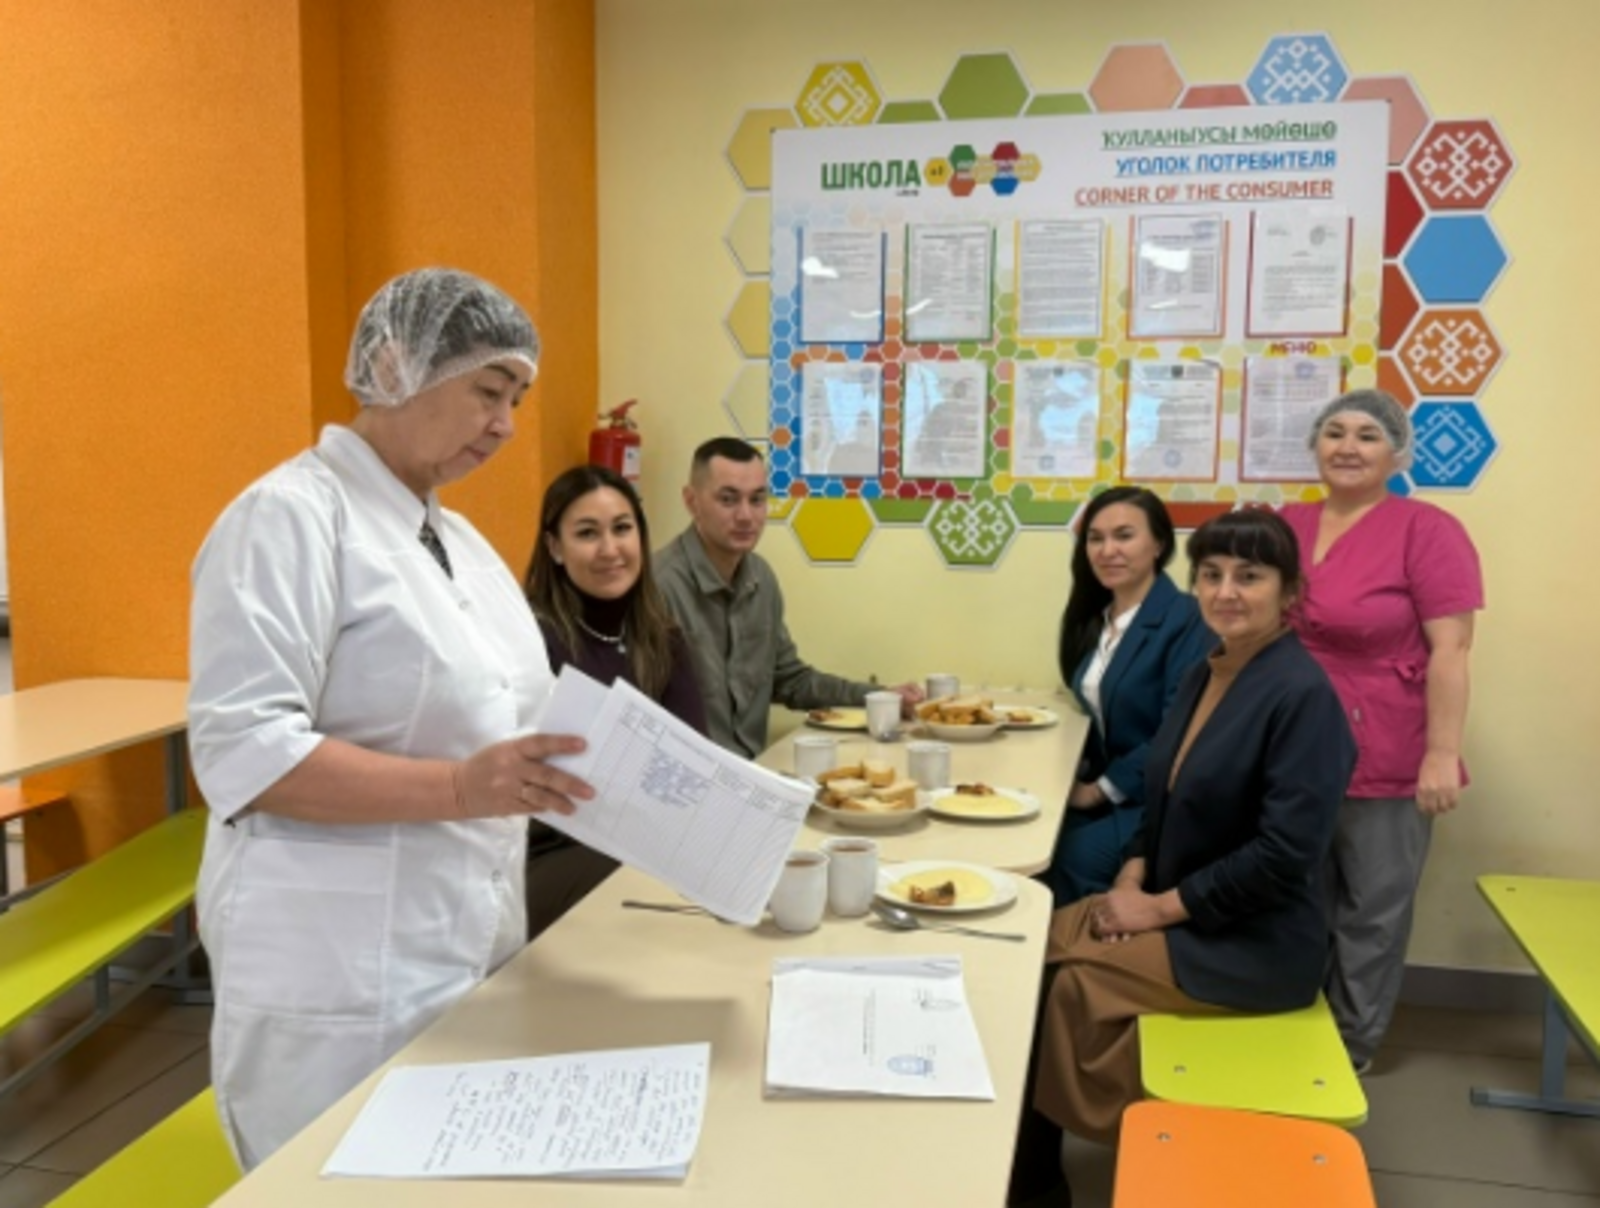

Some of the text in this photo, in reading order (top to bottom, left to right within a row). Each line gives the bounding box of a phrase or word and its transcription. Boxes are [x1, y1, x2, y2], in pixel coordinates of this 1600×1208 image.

[821, 159, 921, 190] ШКОЛА
[1115, 150, 1336, 176] УГОЛОК ПОТРЕБИТЕЛЯ
[1074, 179, 1333, 206] CORNER OF THE CONSUMER
